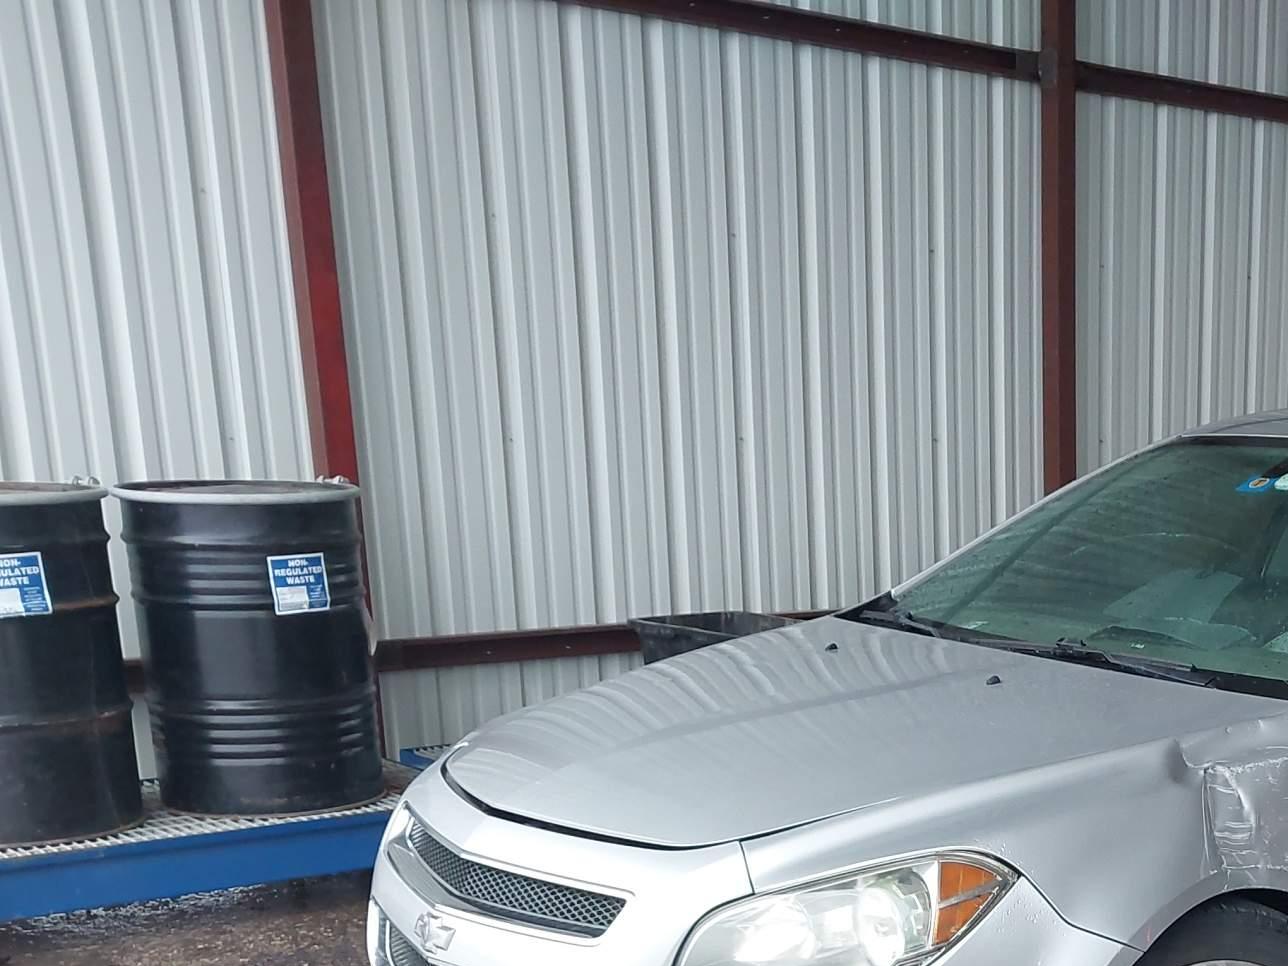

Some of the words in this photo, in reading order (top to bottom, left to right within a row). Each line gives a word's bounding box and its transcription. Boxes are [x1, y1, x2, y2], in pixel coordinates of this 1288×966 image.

[287, 559, 309, 567] NON-
[274, 565, 323, 577] REGULATED
[286, 575, 315, 585] WASTE
